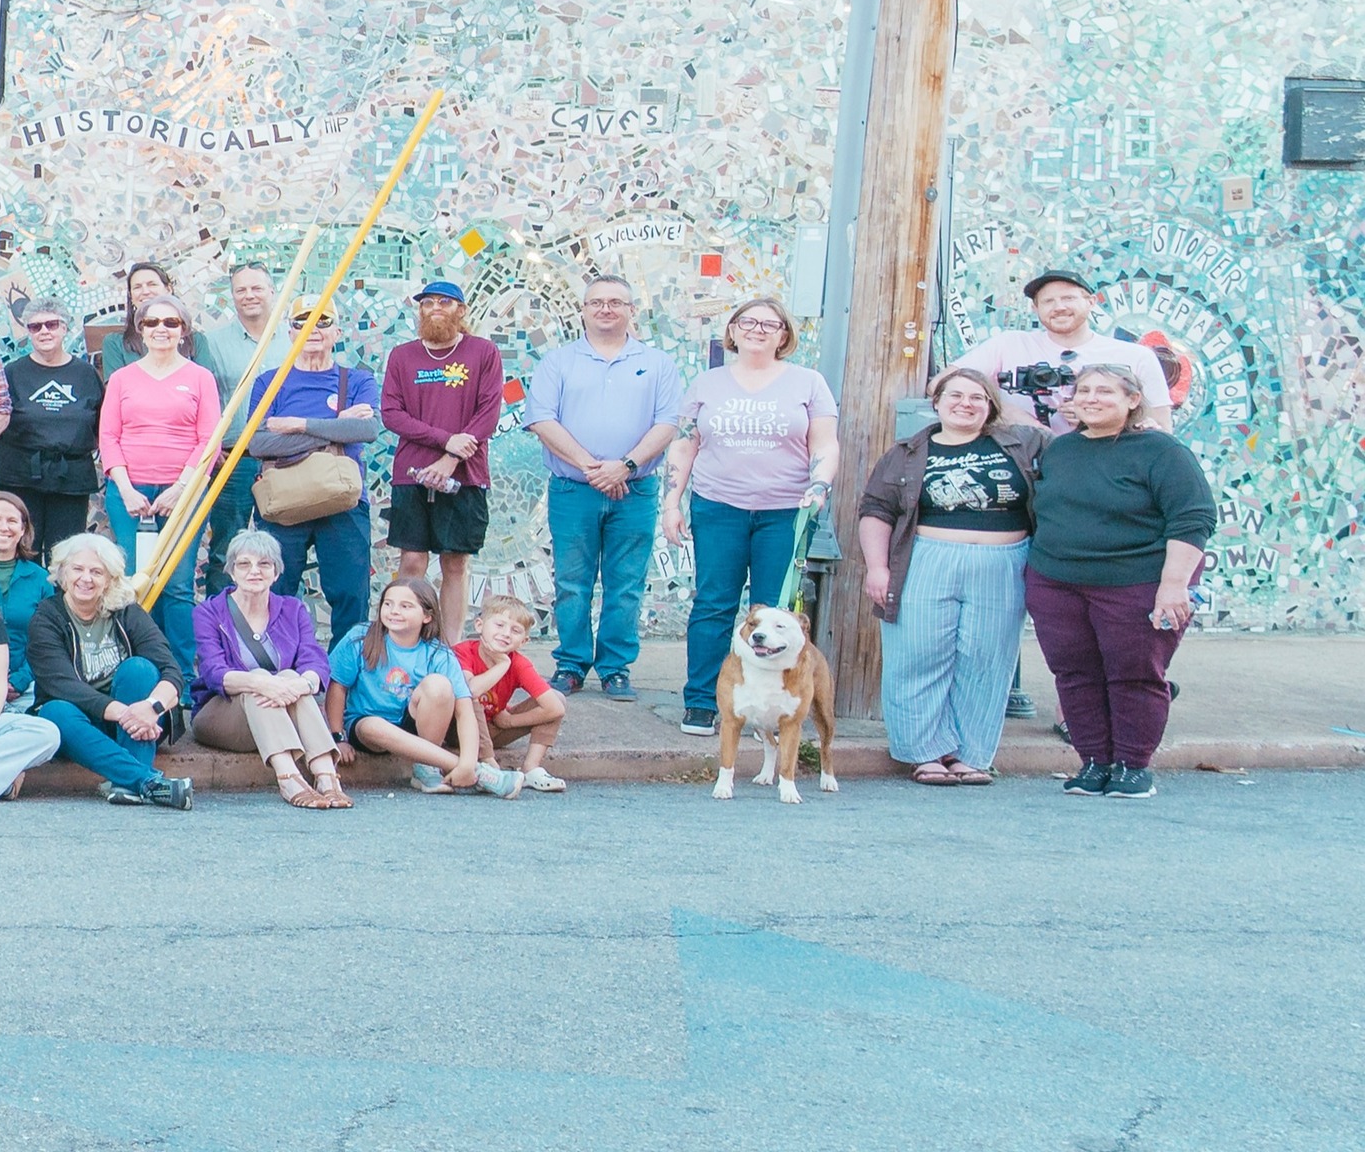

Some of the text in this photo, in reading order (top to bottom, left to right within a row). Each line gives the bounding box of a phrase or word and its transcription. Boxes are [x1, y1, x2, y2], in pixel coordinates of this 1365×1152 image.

[23, 110, 349, 152] HISTORICALLY HIP
[552, 105, 658, 136] CAVES
[1152, 224, 1243, 294] STORER
[1089, 288, 1240, 420] ANCIPATION
[417, 368, 444, 379] Earth
[44, 391, 61, 399] MC
[709, 413, 790, 437] Willa's
[723, 436, 776, 449] Bookshop
